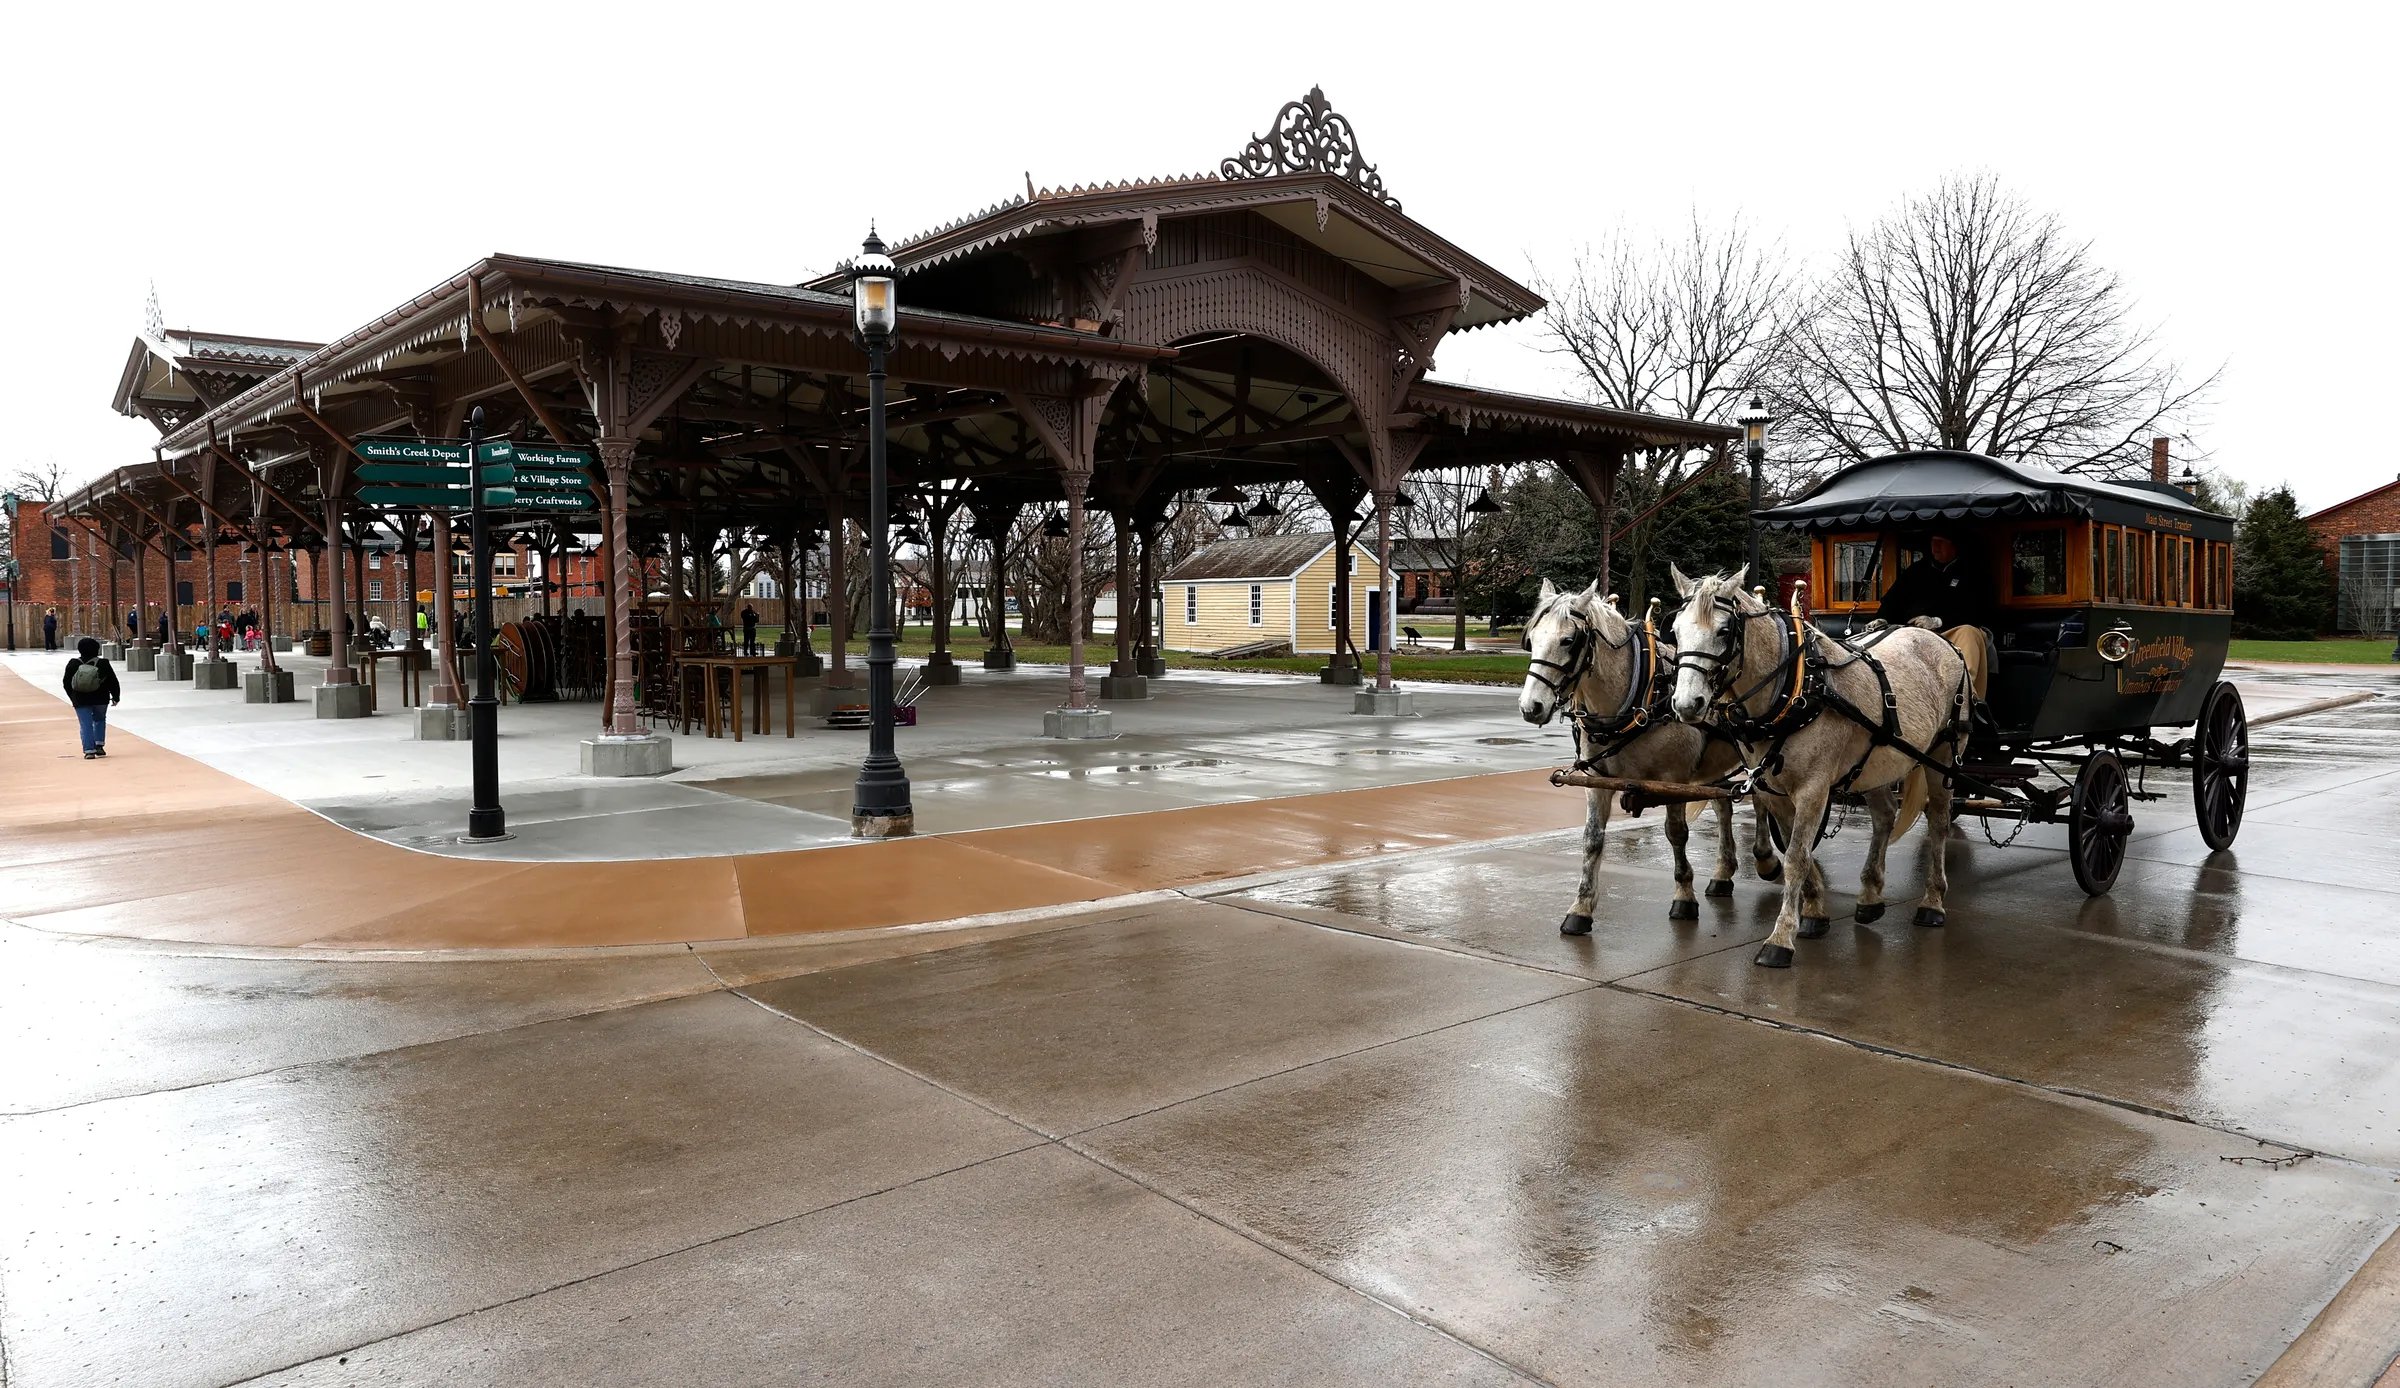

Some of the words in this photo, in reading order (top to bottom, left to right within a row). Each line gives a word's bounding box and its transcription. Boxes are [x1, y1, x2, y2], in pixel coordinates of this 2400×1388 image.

[403, 447, 430, 457] Creek
[432, 448, 460, 460] Depot
[517, 453, 554, 465] Working
[556, 454, 581, 464] Farms
[520, 474, 529, 483] &
[530, 475, 559, 486] Village
[560, 476, 582, 485] Store
[535, 496, 582, 505] Craftworks
[2158, 514, 2173, 528] Street
[2131, 636, 2170, 668] Greenfield
[2171, 636, 2194, 670] Village
[2121, 678, 2152, 695] Omnibus
[2151, 677, 2183, 695] Company
